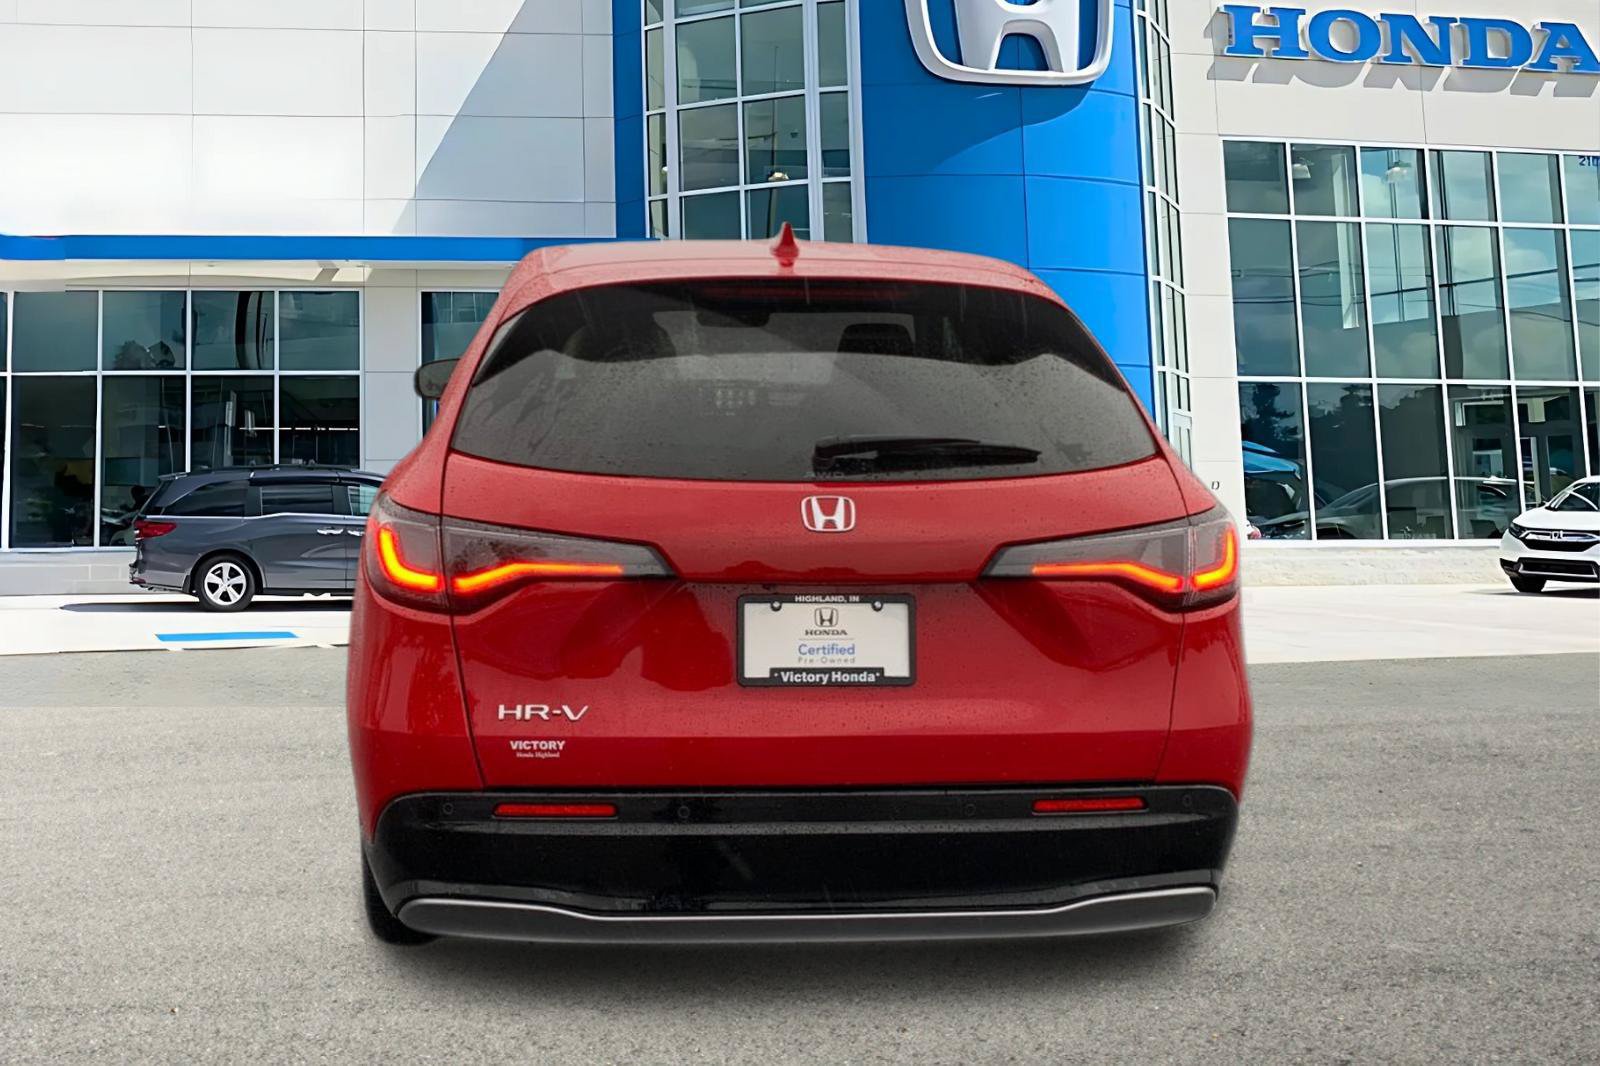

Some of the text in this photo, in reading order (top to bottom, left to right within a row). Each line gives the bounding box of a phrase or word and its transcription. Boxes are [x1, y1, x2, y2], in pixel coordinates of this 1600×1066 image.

[1222, 4, 1600, 74] HONDA
[798, 643, 856, 656] Certified
[780, 671, 876, 685] Victory Honda
[498, 704, 589, 721] HR-V
[509, 740, 566, 751] VICTORY
